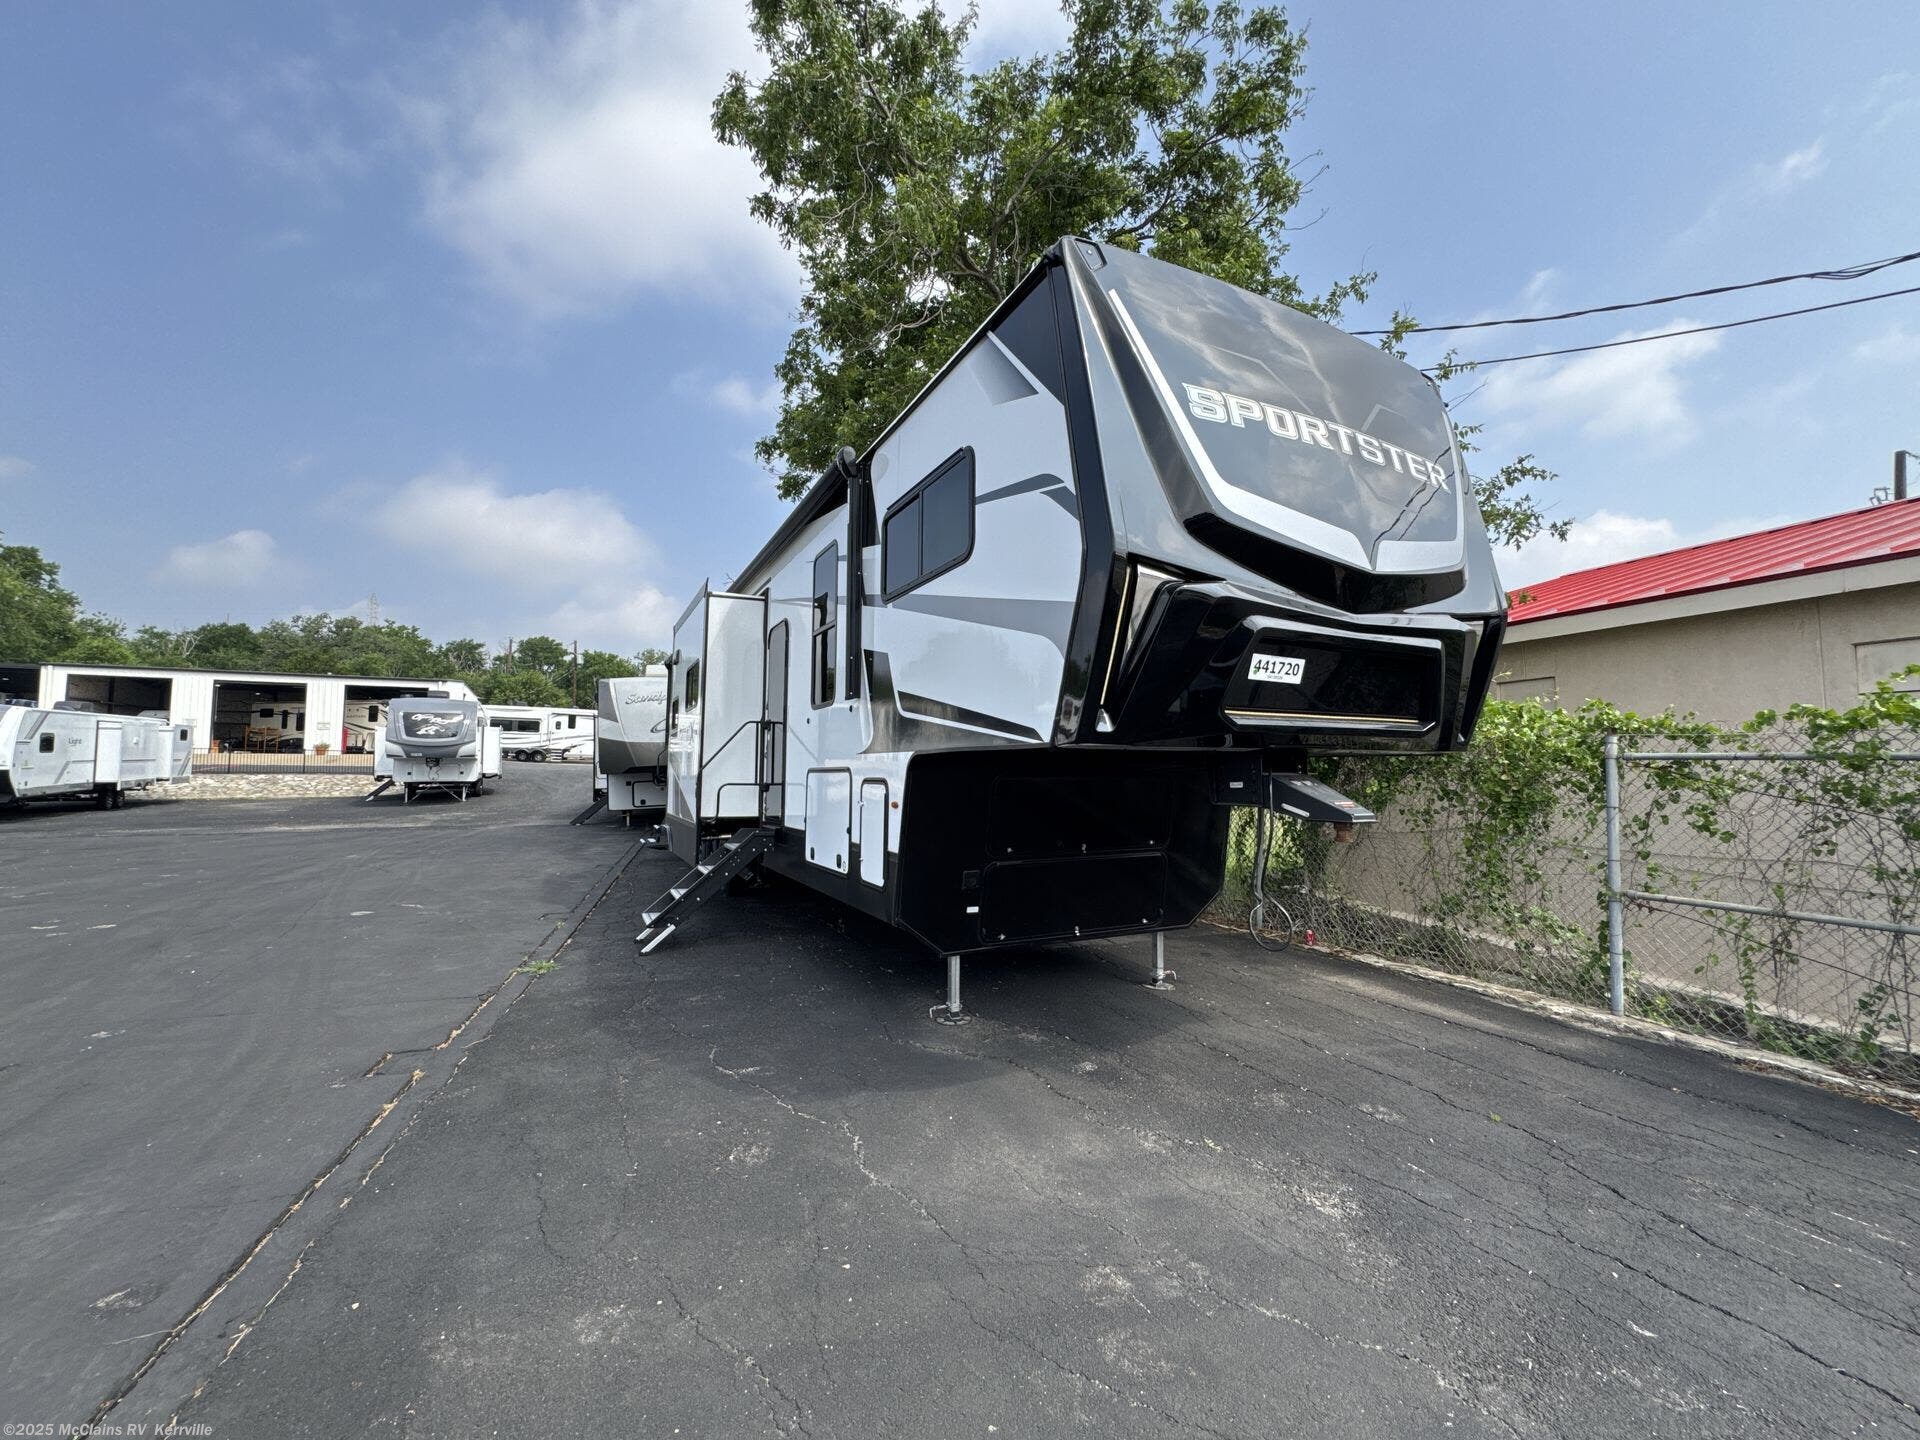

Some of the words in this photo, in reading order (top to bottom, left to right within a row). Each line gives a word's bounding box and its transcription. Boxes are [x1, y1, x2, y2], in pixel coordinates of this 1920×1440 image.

[1182, 383, 1451, 494] SPORTSTER
[1253, 659, 1300, 676] 441720
[68, 737, 82, 747] Light
